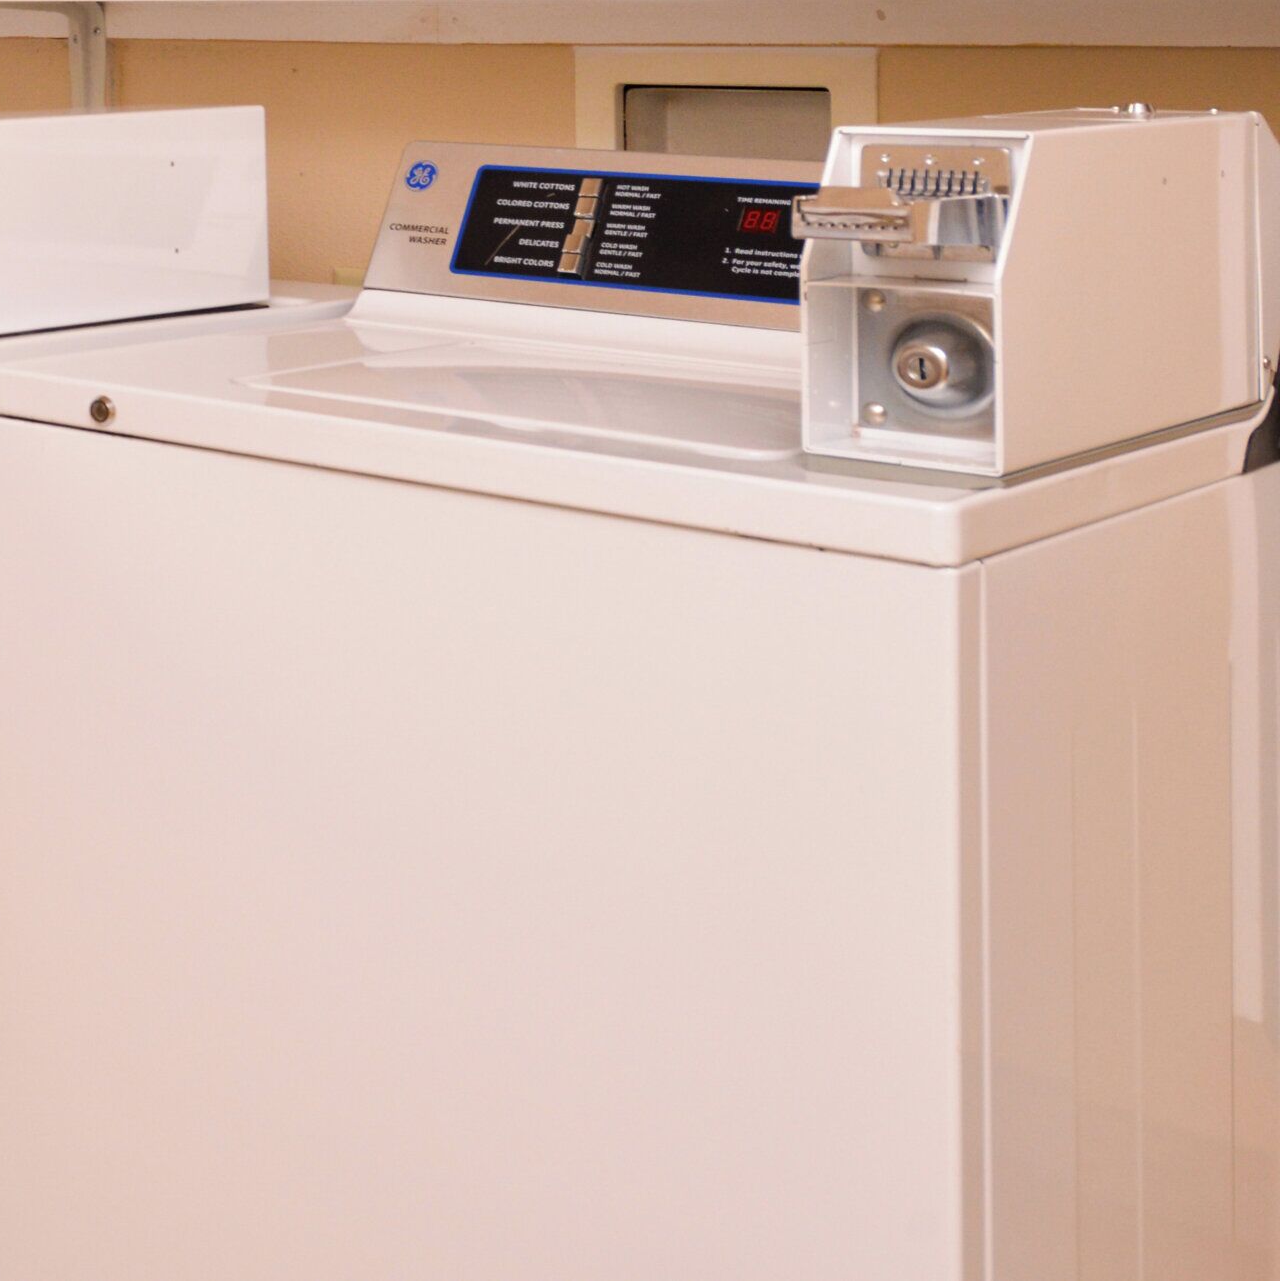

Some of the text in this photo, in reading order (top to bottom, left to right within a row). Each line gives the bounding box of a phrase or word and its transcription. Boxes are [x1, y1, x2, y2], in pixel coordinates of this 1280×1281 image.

[513, 180, 576, 192] WHITE COTTONS
[496, 198, 571, 211] COLORED COTTONS
[737, 196, 792, 206] TIME REMAINING
[389, 223, 449, 235] COMMERCIAL
[493, 217, 565, 230] PERMANENT PRESS
[409, 236, 447, 246] WASHER
[518, 238, 560, 249] DELICATES
[734, 247, 754, 255] Read
[754, 249, 798, 259] instructions
[493, 255, 555, 268] BRIGHT COLORS
[731, 266, 752, 274] Cycle
